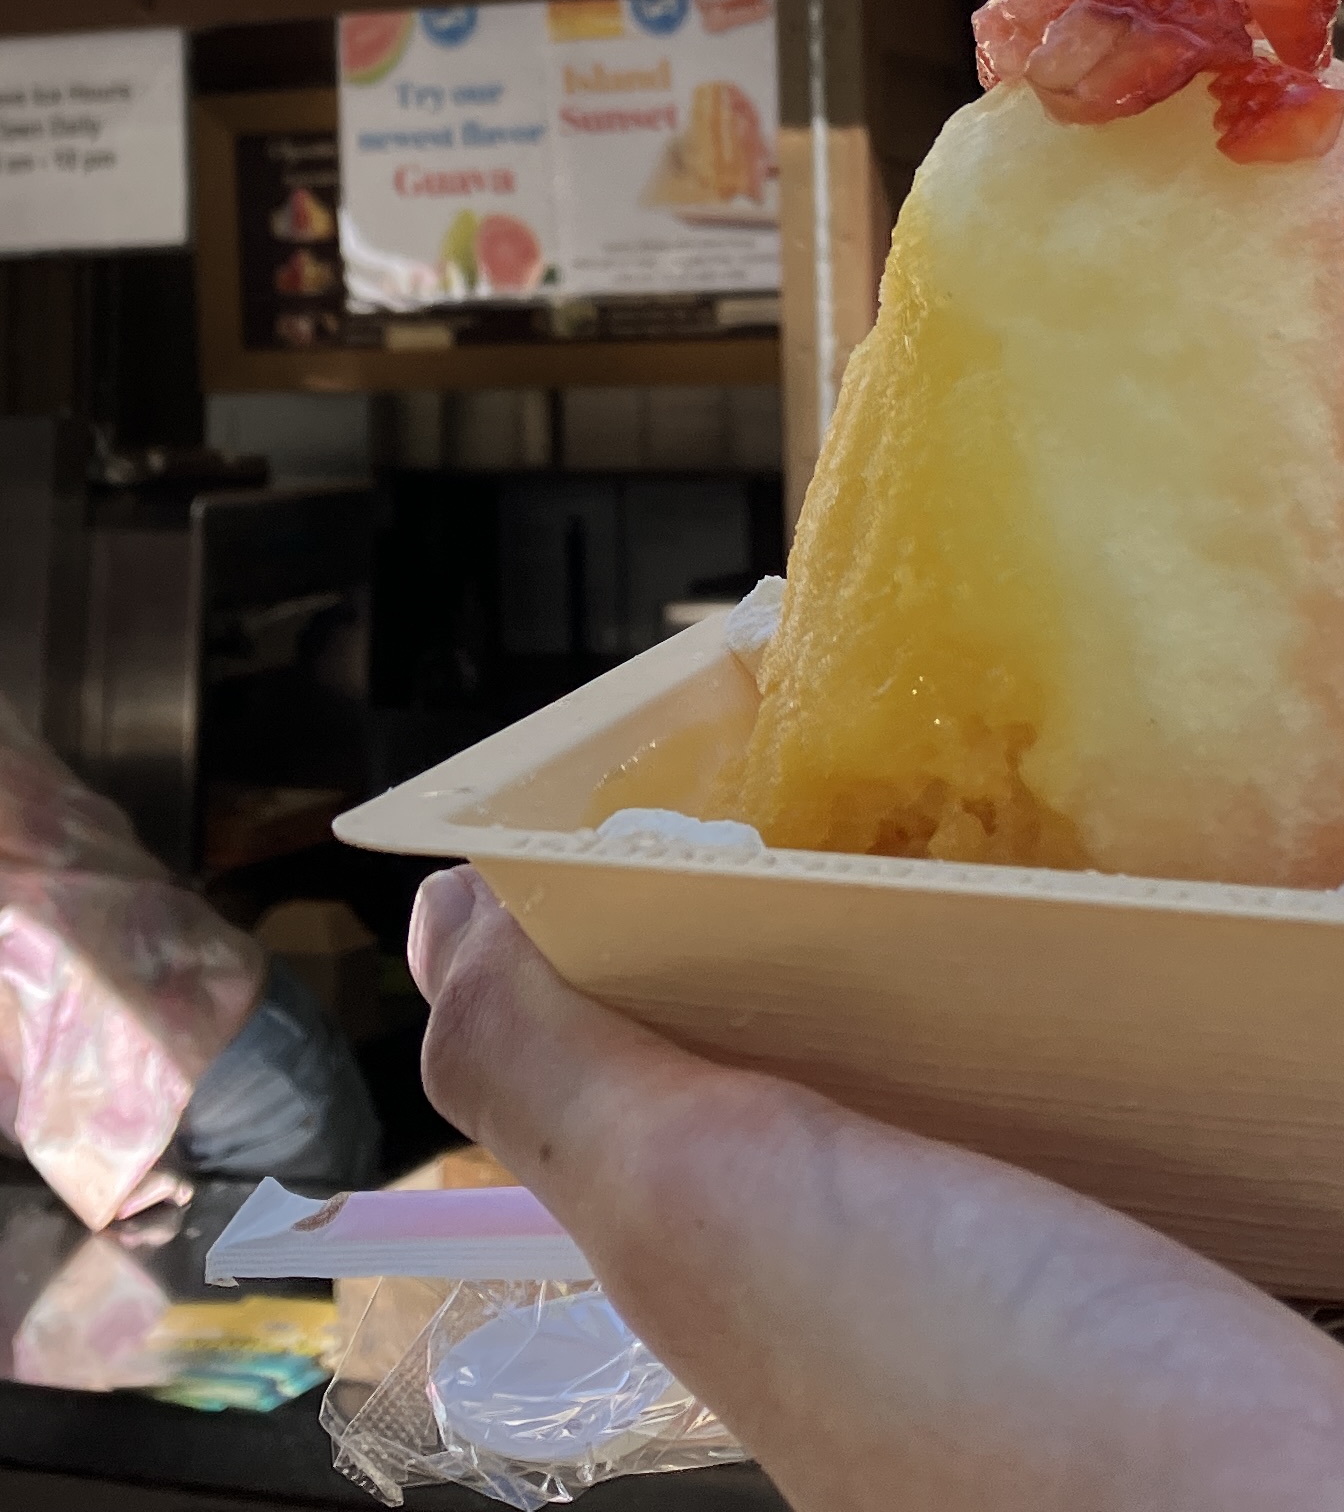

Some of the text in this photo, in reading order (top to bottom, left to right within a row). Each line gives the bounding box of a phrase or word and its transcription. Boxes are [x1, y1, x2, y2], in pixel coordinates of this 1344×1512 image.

[563, 60, 672, 95] Island
[397, 81, 505, 114] Try our
[558, 103, 678, 135] Sunset
[357, 120, 548, 152] newest flavor
[393, 163, 517, 200] Guava
